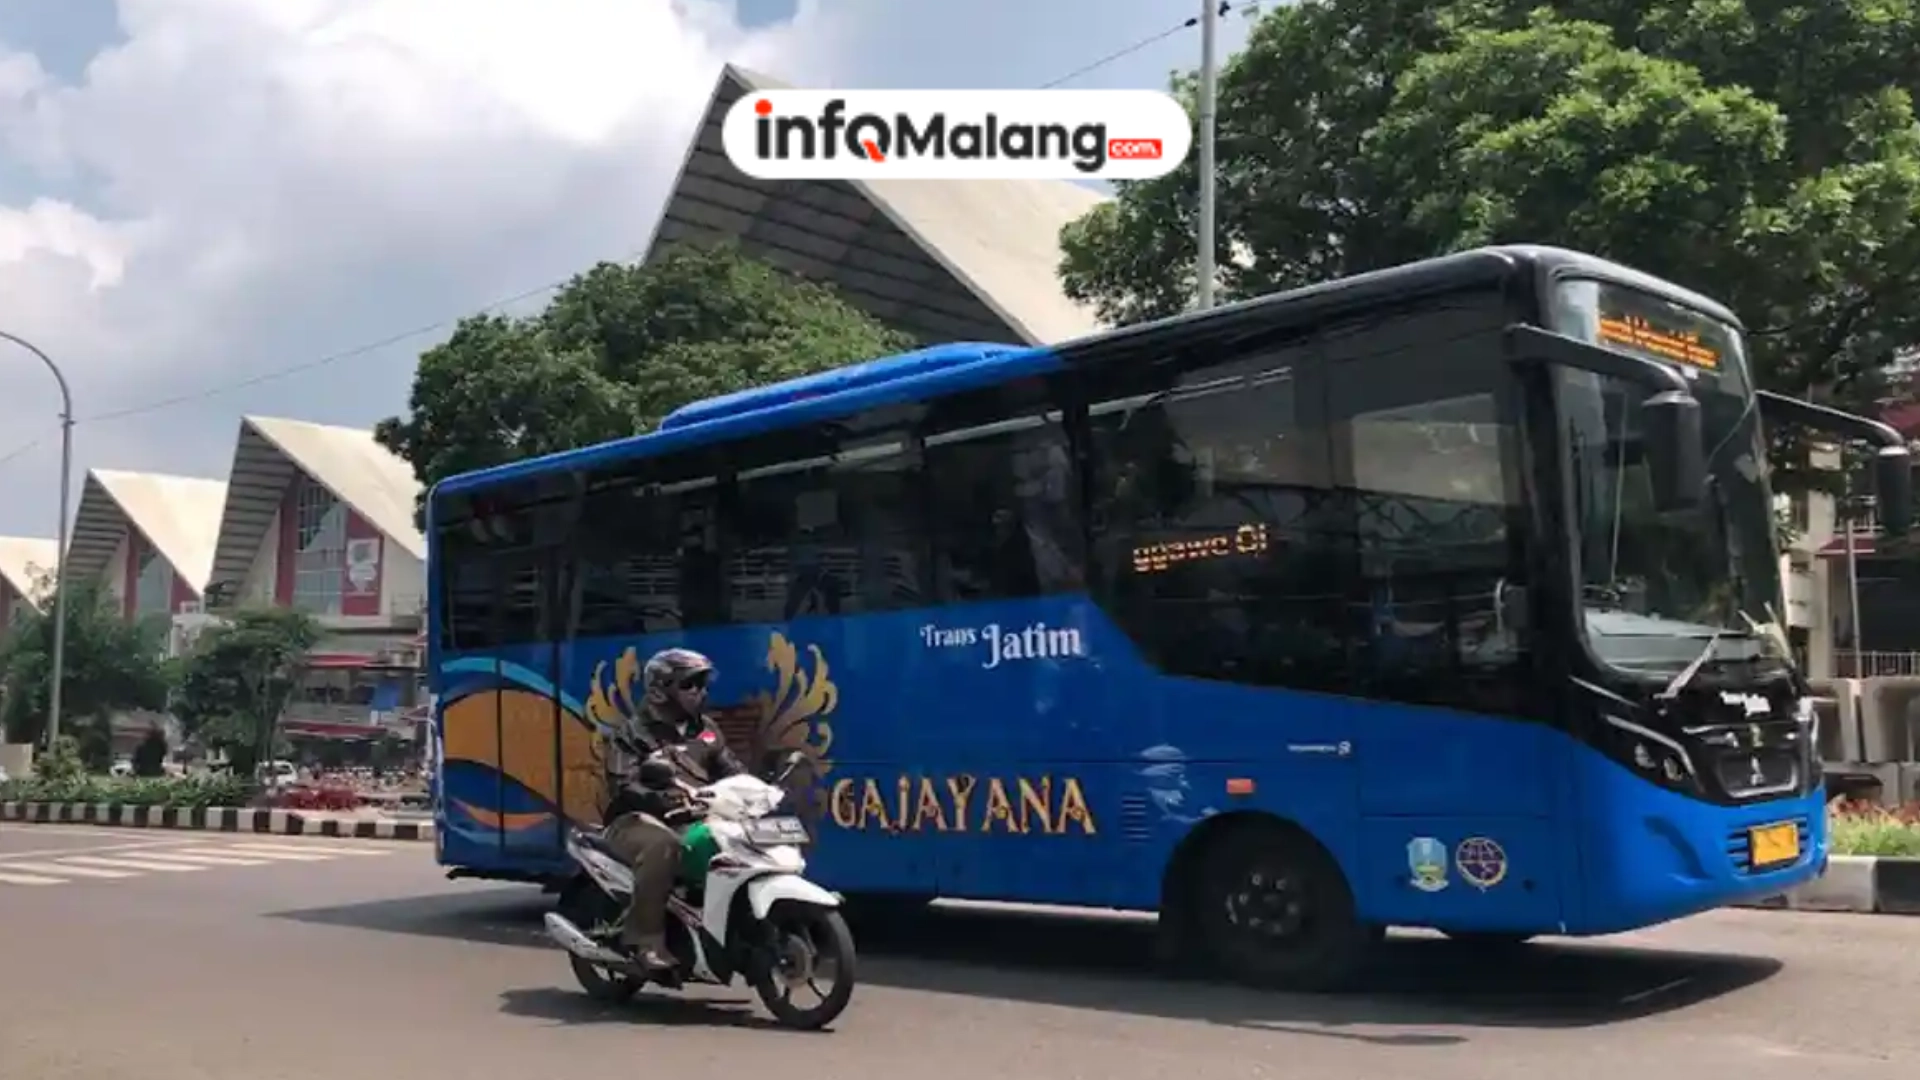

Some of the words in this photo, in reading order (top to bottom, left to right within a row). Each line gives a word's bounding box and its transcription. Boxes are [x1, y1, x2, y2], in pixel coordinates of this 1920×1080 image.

[919, 624, 977, 647] Trans
[981, 622, 1083, 669] Jatim
[831, 774, 1096, 833] GAJAYANA
